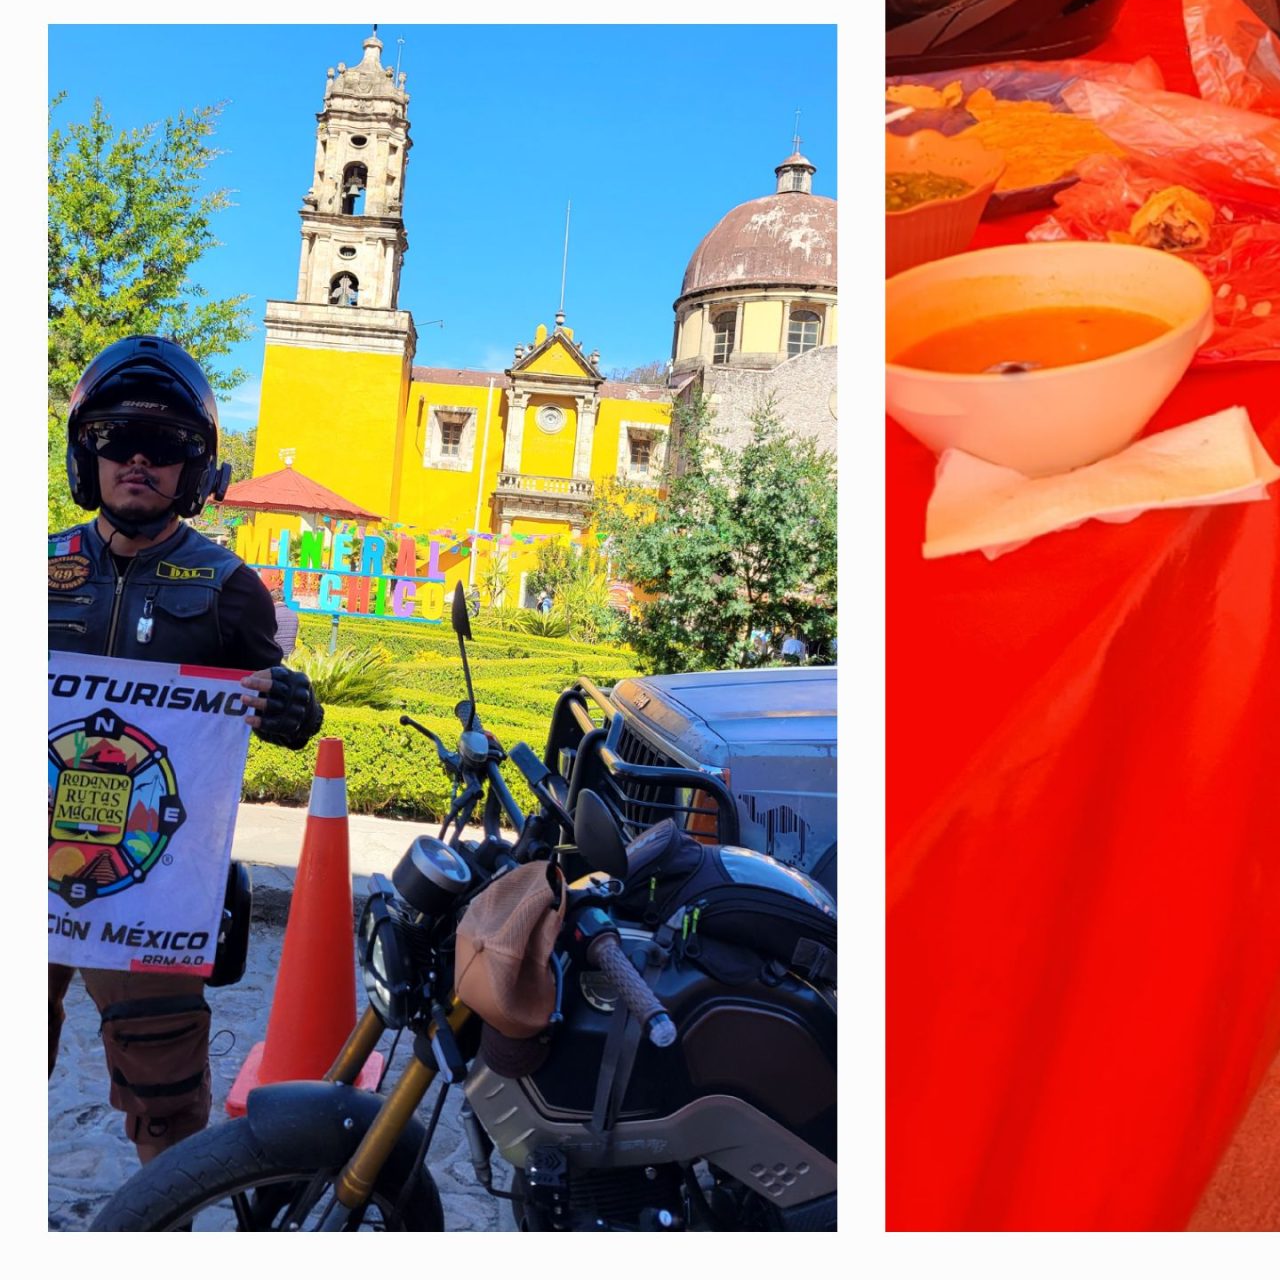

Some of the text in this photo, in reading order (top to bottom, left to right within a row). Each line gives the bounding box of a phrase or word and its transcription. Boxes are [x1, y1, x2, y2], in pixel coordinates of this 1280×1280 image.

[121, 400, 168, 411] SHAFT
[236, 524, 446, 582] MINERAL
[169, 568, 201, 580] DAL
[319, 573, 445, 620] CHICO
[94, 717, 115, 733] N
[163, 807, 180, 823] E
[70, 882, 87, 899] S
[100, 921, 209, 951] MÉXICO
